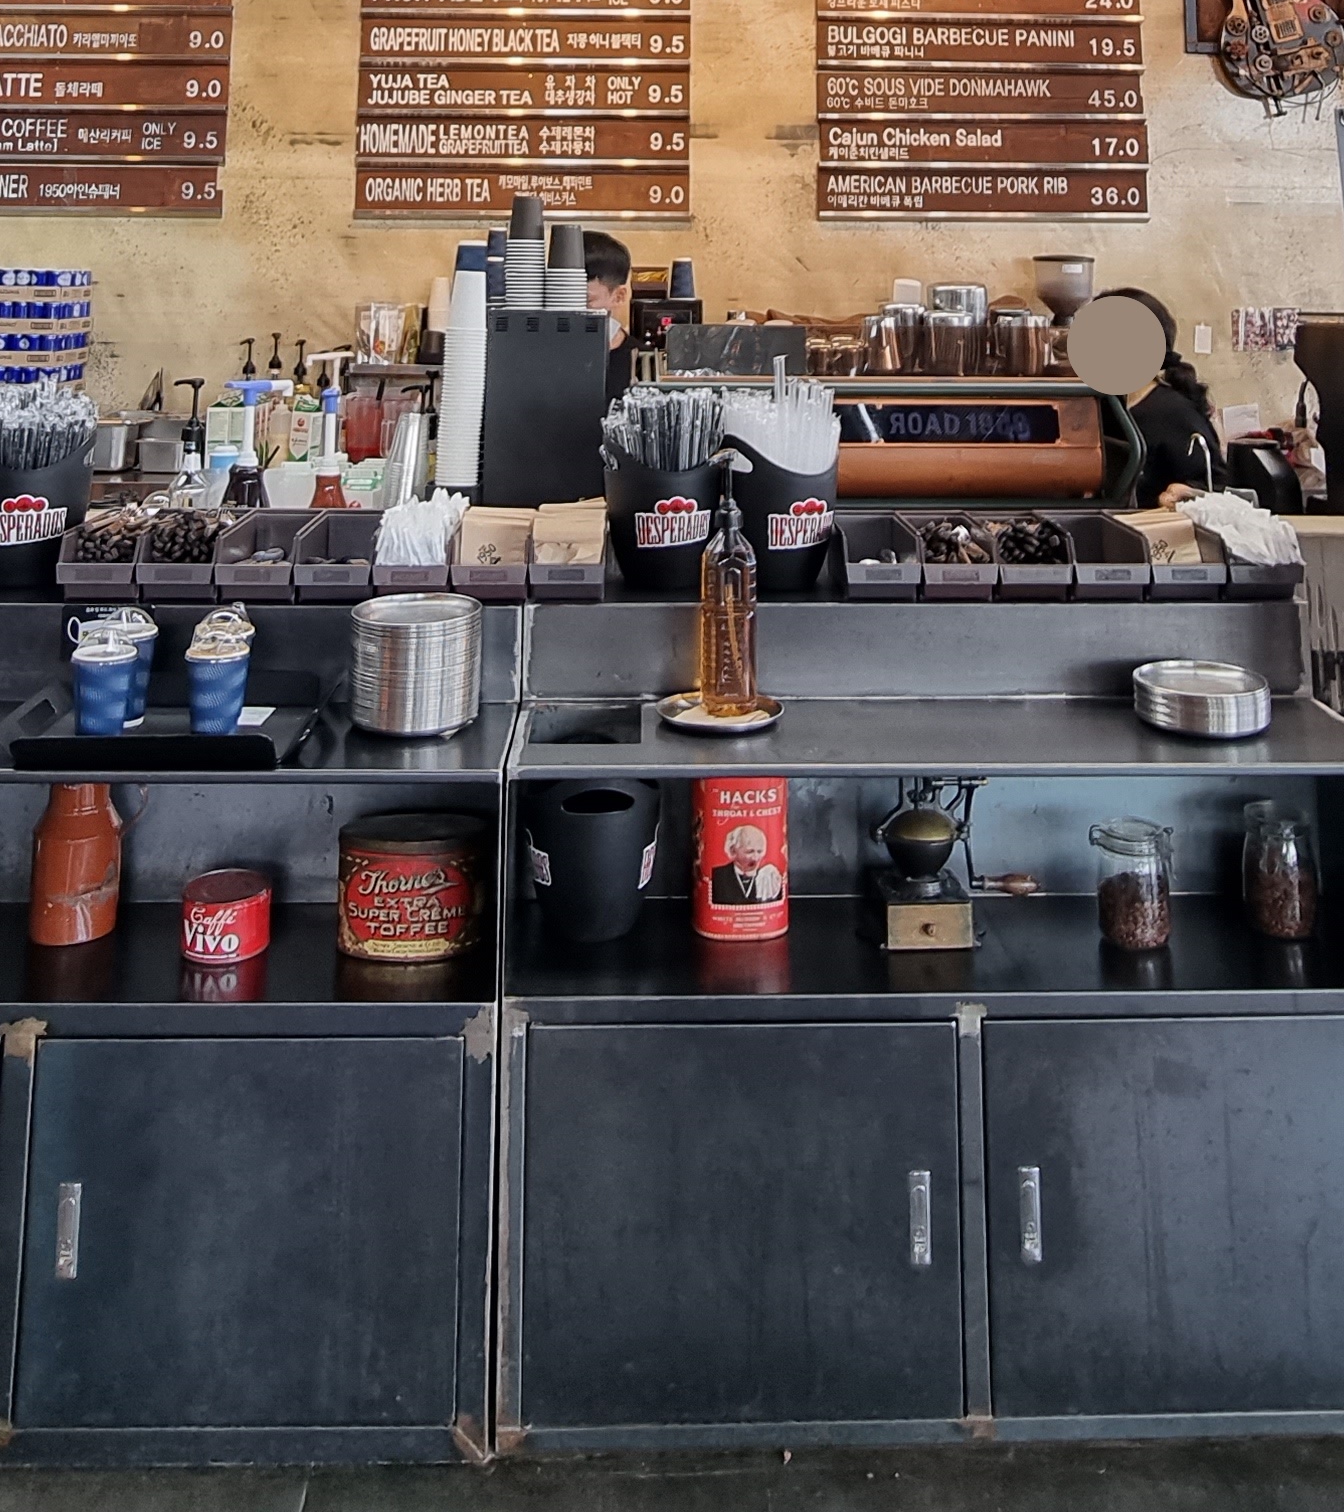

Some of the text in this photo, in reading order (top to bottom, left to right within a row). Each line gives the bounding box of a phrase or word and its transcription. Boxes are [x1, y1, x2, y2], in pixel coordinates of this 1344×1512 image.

[827, 26, 1135, 56] BULGOGI BARBECUE PANINI 19.5
[186, 80, 220, 98] 9.0
[370, 74, 449, 88] YUJA TEA
[368, 86, 682, 105] JUJUBE GINGER TEA HOT 9.5
[2, 119, 67, 138] COFFEE
[183, 132, 217, 148] 9.5
[829, 128, 1139, 156] Cajun Chicken Salad 17.0
[182, 182, 215, 199] 9.5
[365, 180, 422, 201] ORGANIC
[427, 179, 461, 201] HERB
[466, 179, 490, 202] TEA
[649, 187, 684, 203] 9.0
[720, 789, 777, 803] HACKS
[374, 896, 440, 908] EXTRA
[184, 919, 239, 952] Vivo
[366, 922, 448, 936] TOFFEE
